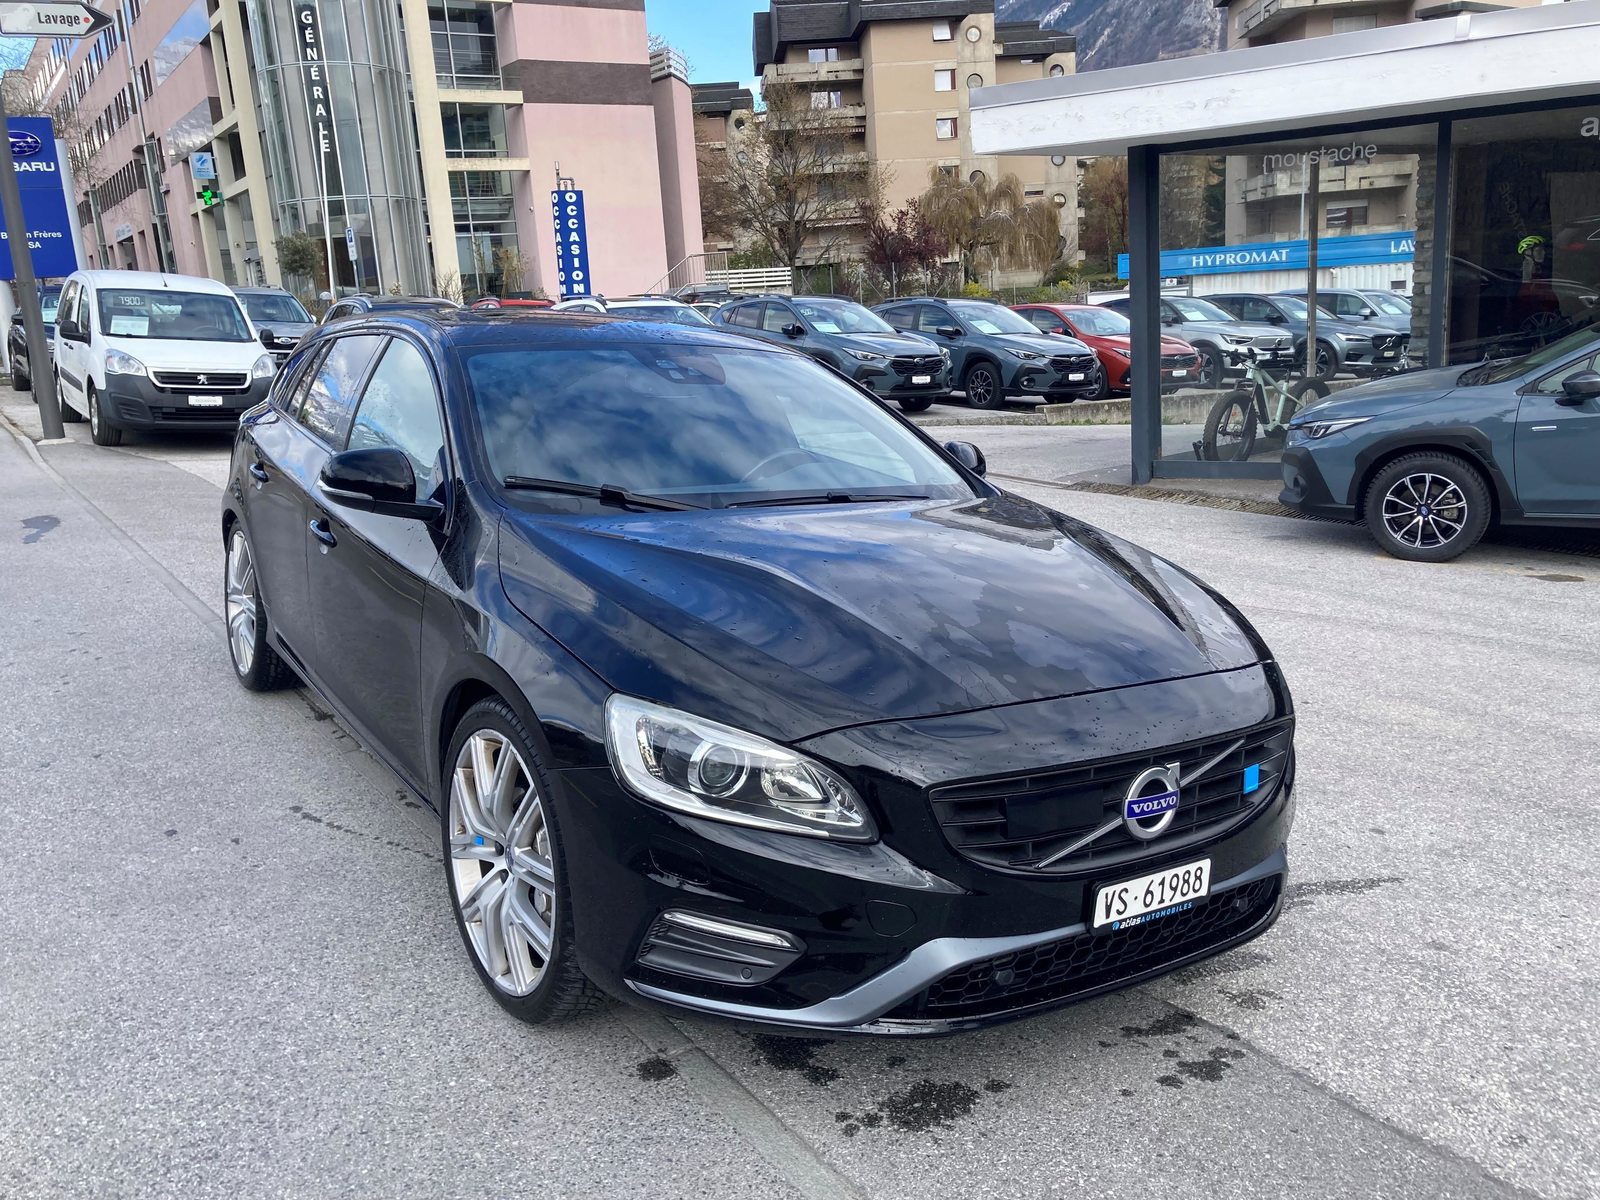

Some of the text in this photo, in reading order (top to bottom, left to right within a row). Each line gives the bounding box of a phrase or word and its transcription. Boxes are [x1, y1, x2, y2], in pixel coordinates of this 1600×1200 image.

[37, 12, 80, 27] Lavage
[300, 10, 331, 152] GÉNÉRALE
[33, 230, 62, 238] Frères
[565, 192, 585, 294] OCCASION
[28, 241, 42, 249] SA
[551, 192, 567, 295] OCCASION
[1192, 249, 1290, 267] HYPROMAT
[1130, 795, 1177, 814] VOLVO
